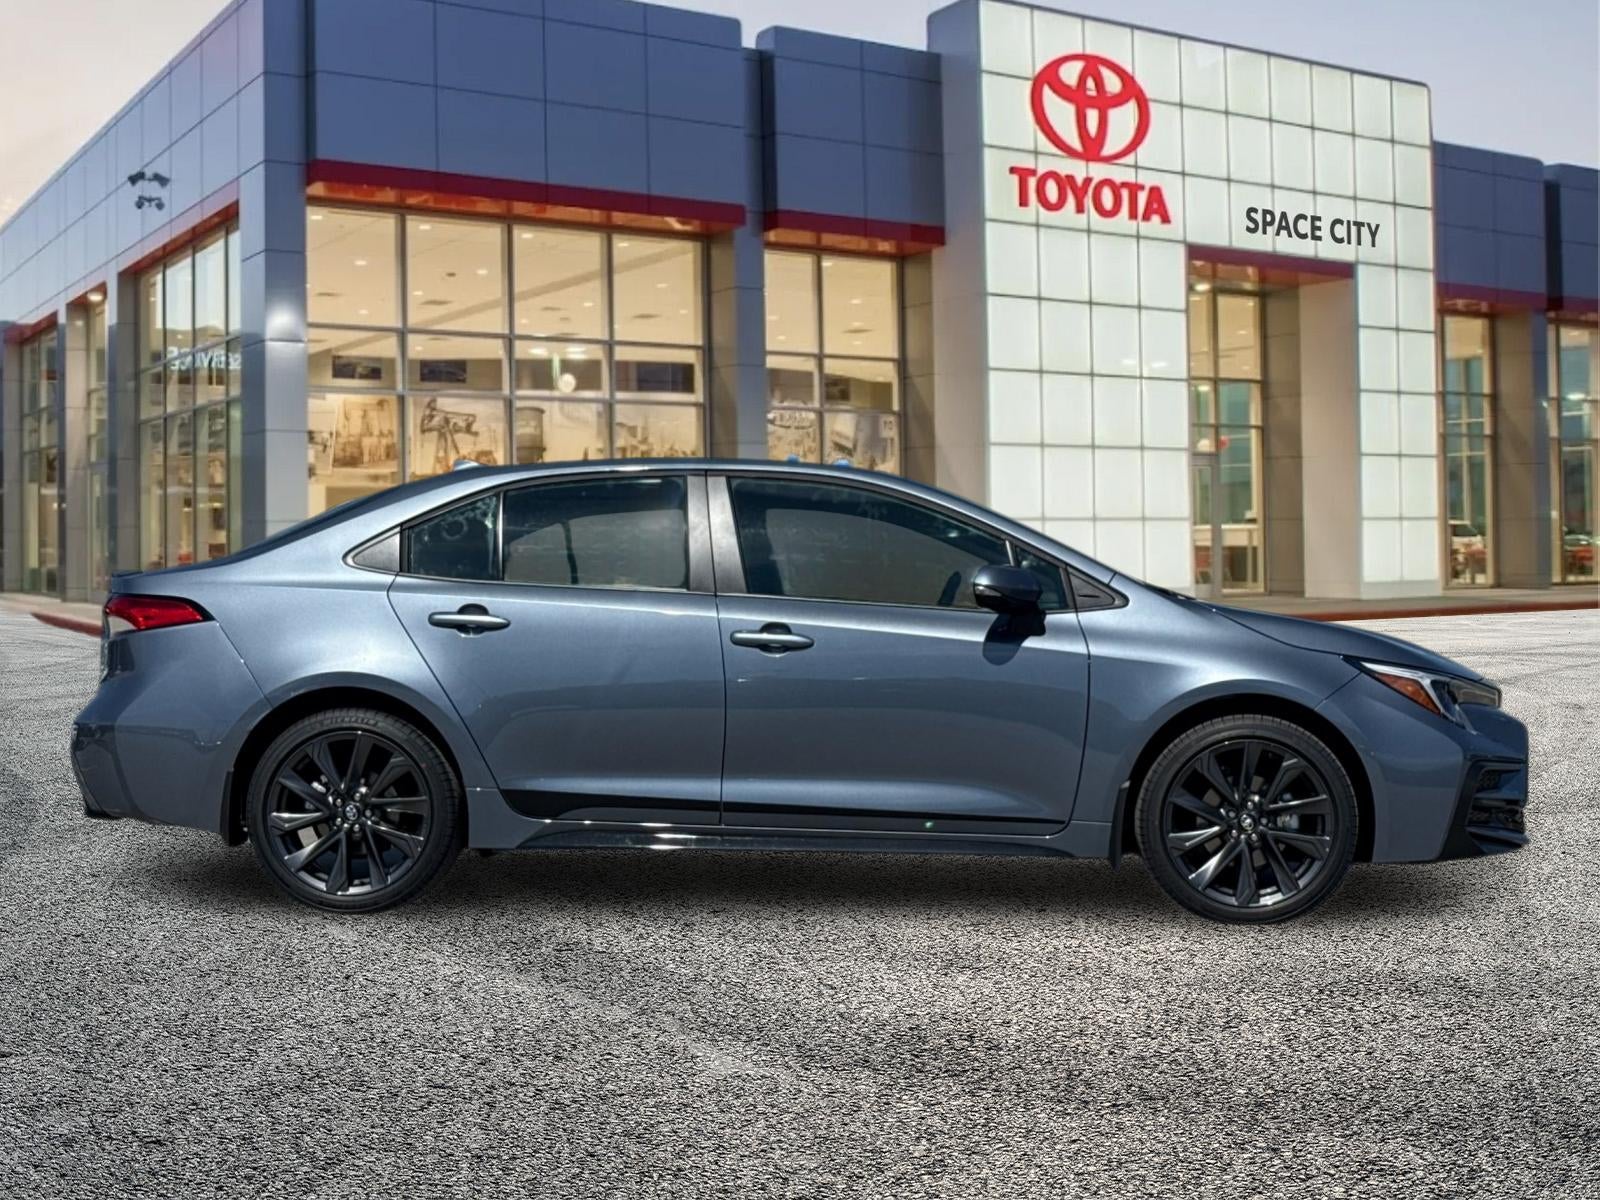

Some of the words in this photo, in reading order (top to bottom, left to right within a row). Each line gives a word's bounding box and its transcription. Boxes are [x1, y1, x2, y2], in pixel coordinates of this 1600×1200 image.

[1010, 166, 1172, 224] TOYOTA
[1245, 207, 1323, 242] SPACE
[1329, 218, 1381, 248] CITY
